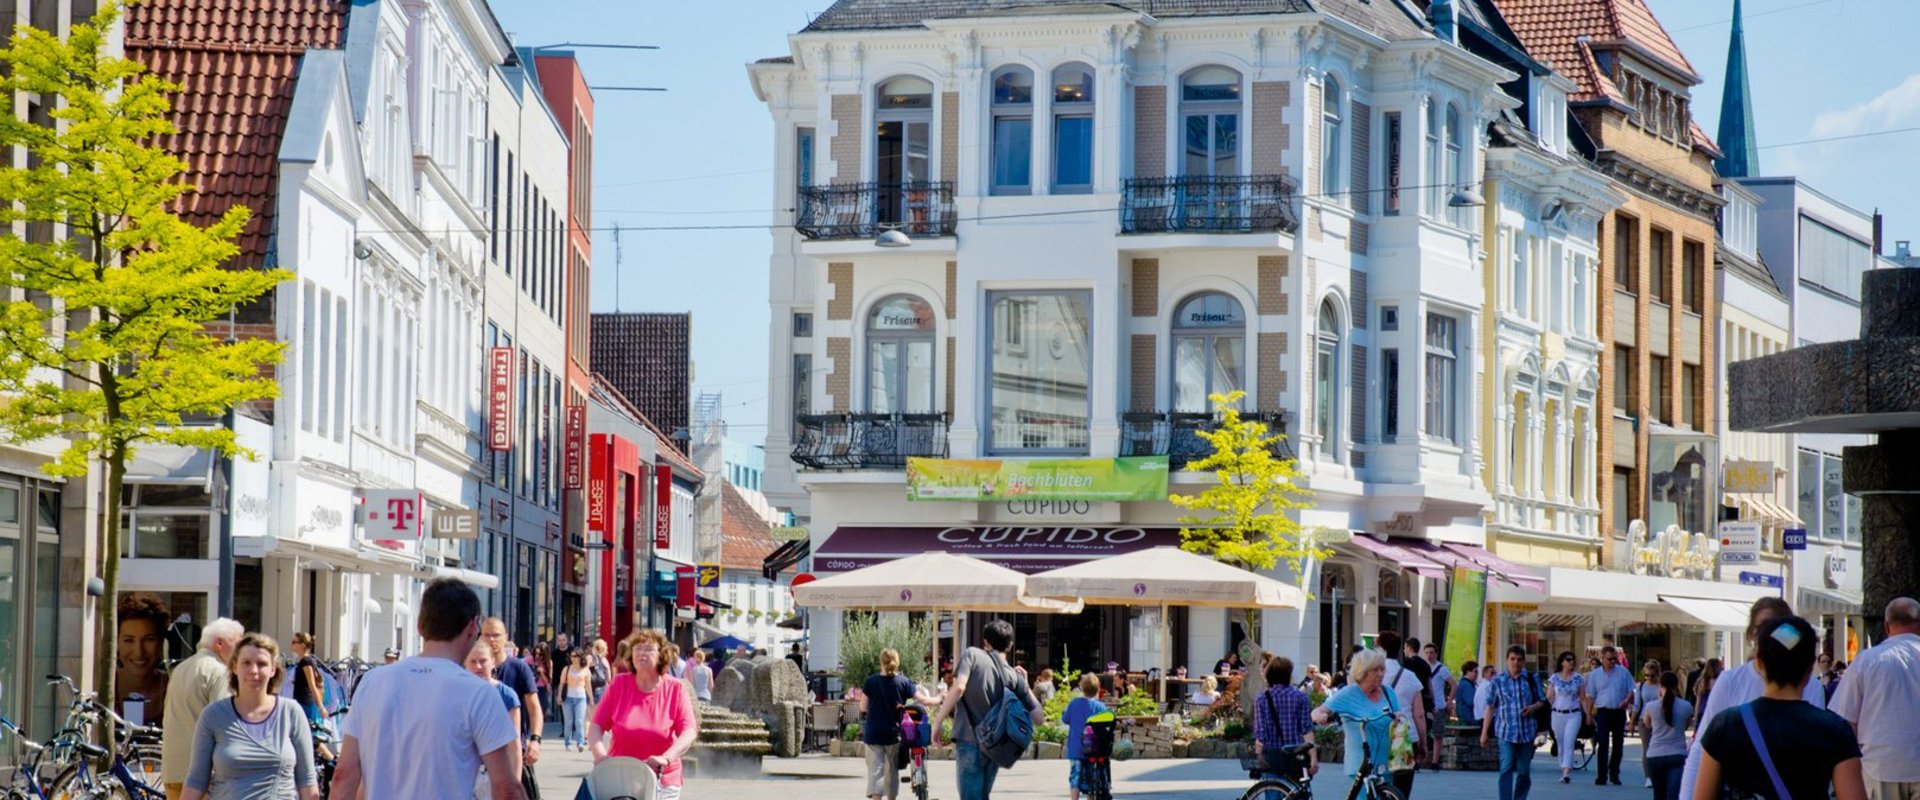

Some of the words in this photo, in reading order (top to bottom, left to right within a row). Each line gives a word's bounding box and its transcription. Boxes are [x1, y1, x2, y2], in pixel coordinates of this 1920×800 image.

[496, 353, 507, 386] THE
[495, 390, 506, 444] STING
[569, 441, 581, 484] STING
[591, 479, 604, 524] ESPRIT
[438, 515, 471, 532] WE
[658, 504, 669, 543] ESPRIT
[1785, 535, 1804, 544] CECIL
